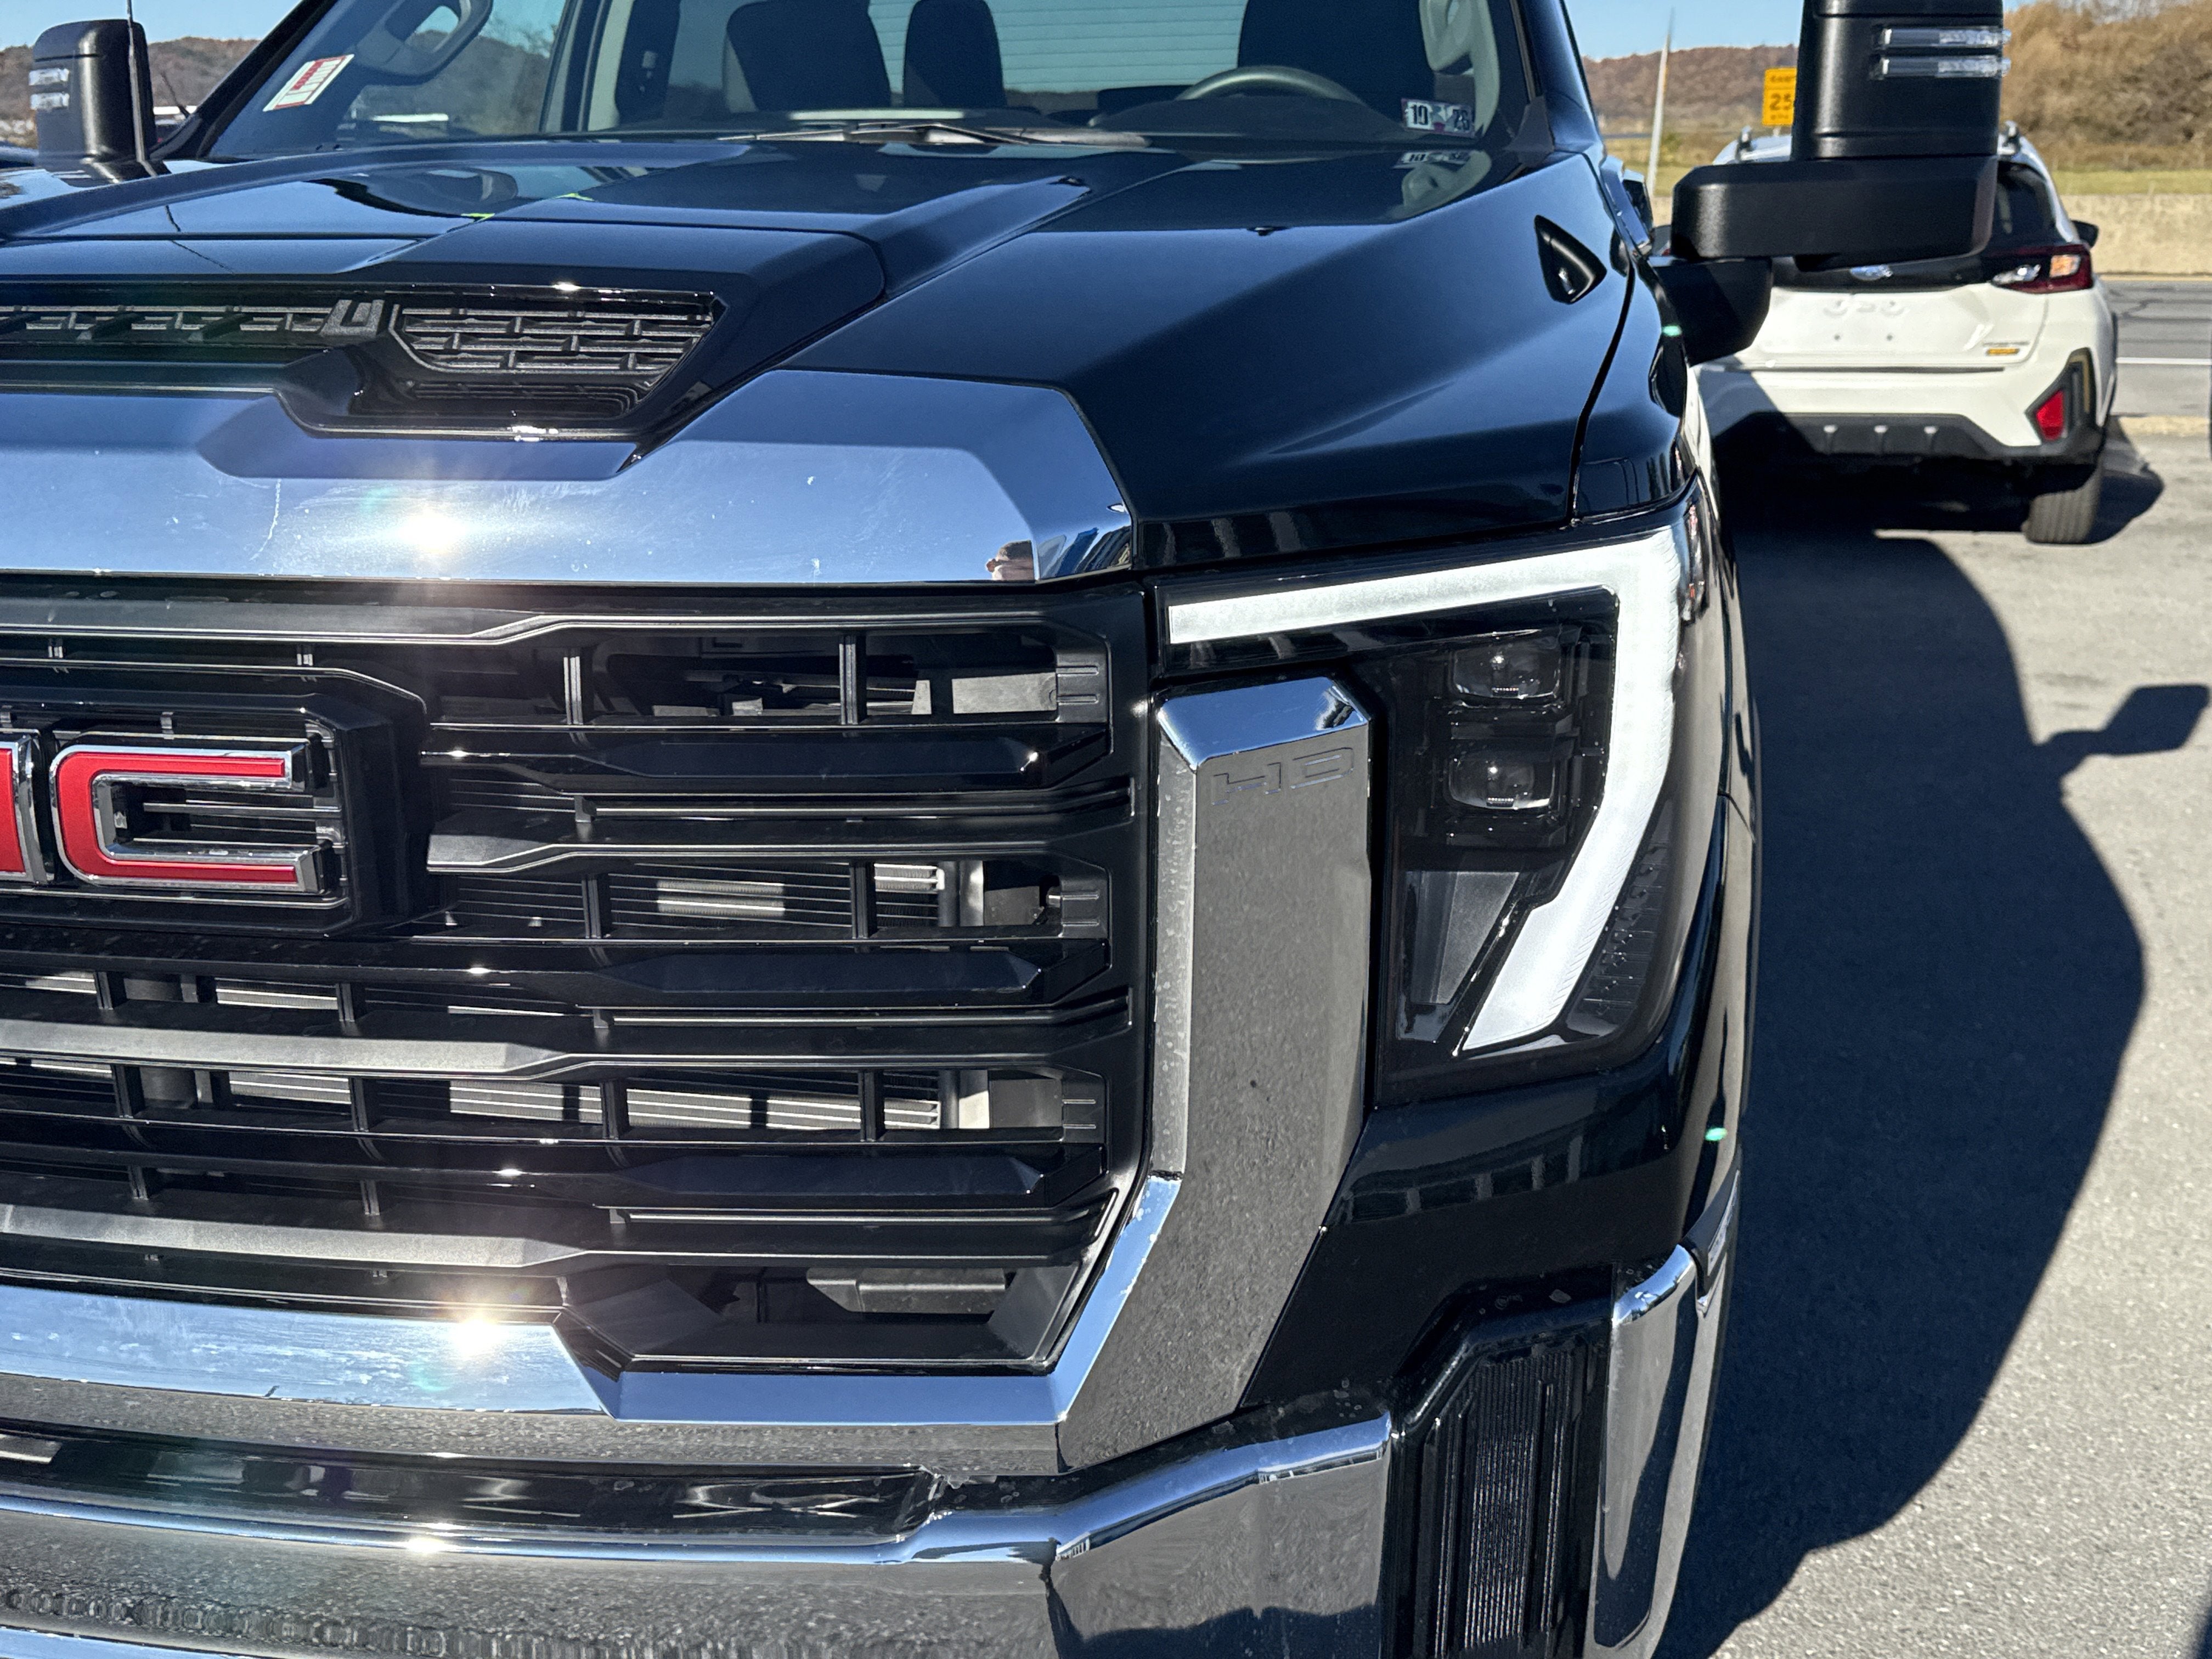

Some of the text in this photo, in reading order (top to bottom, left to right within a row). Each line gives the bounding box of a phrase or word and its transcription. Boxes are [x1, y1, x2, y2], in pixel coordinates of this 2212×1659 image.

[1412, 104, 1429, 125] 10
[1770, 93, 1792, 111] 25
[1211, 747, 1354, 805] HD
[0, 736, 314, 893] C
